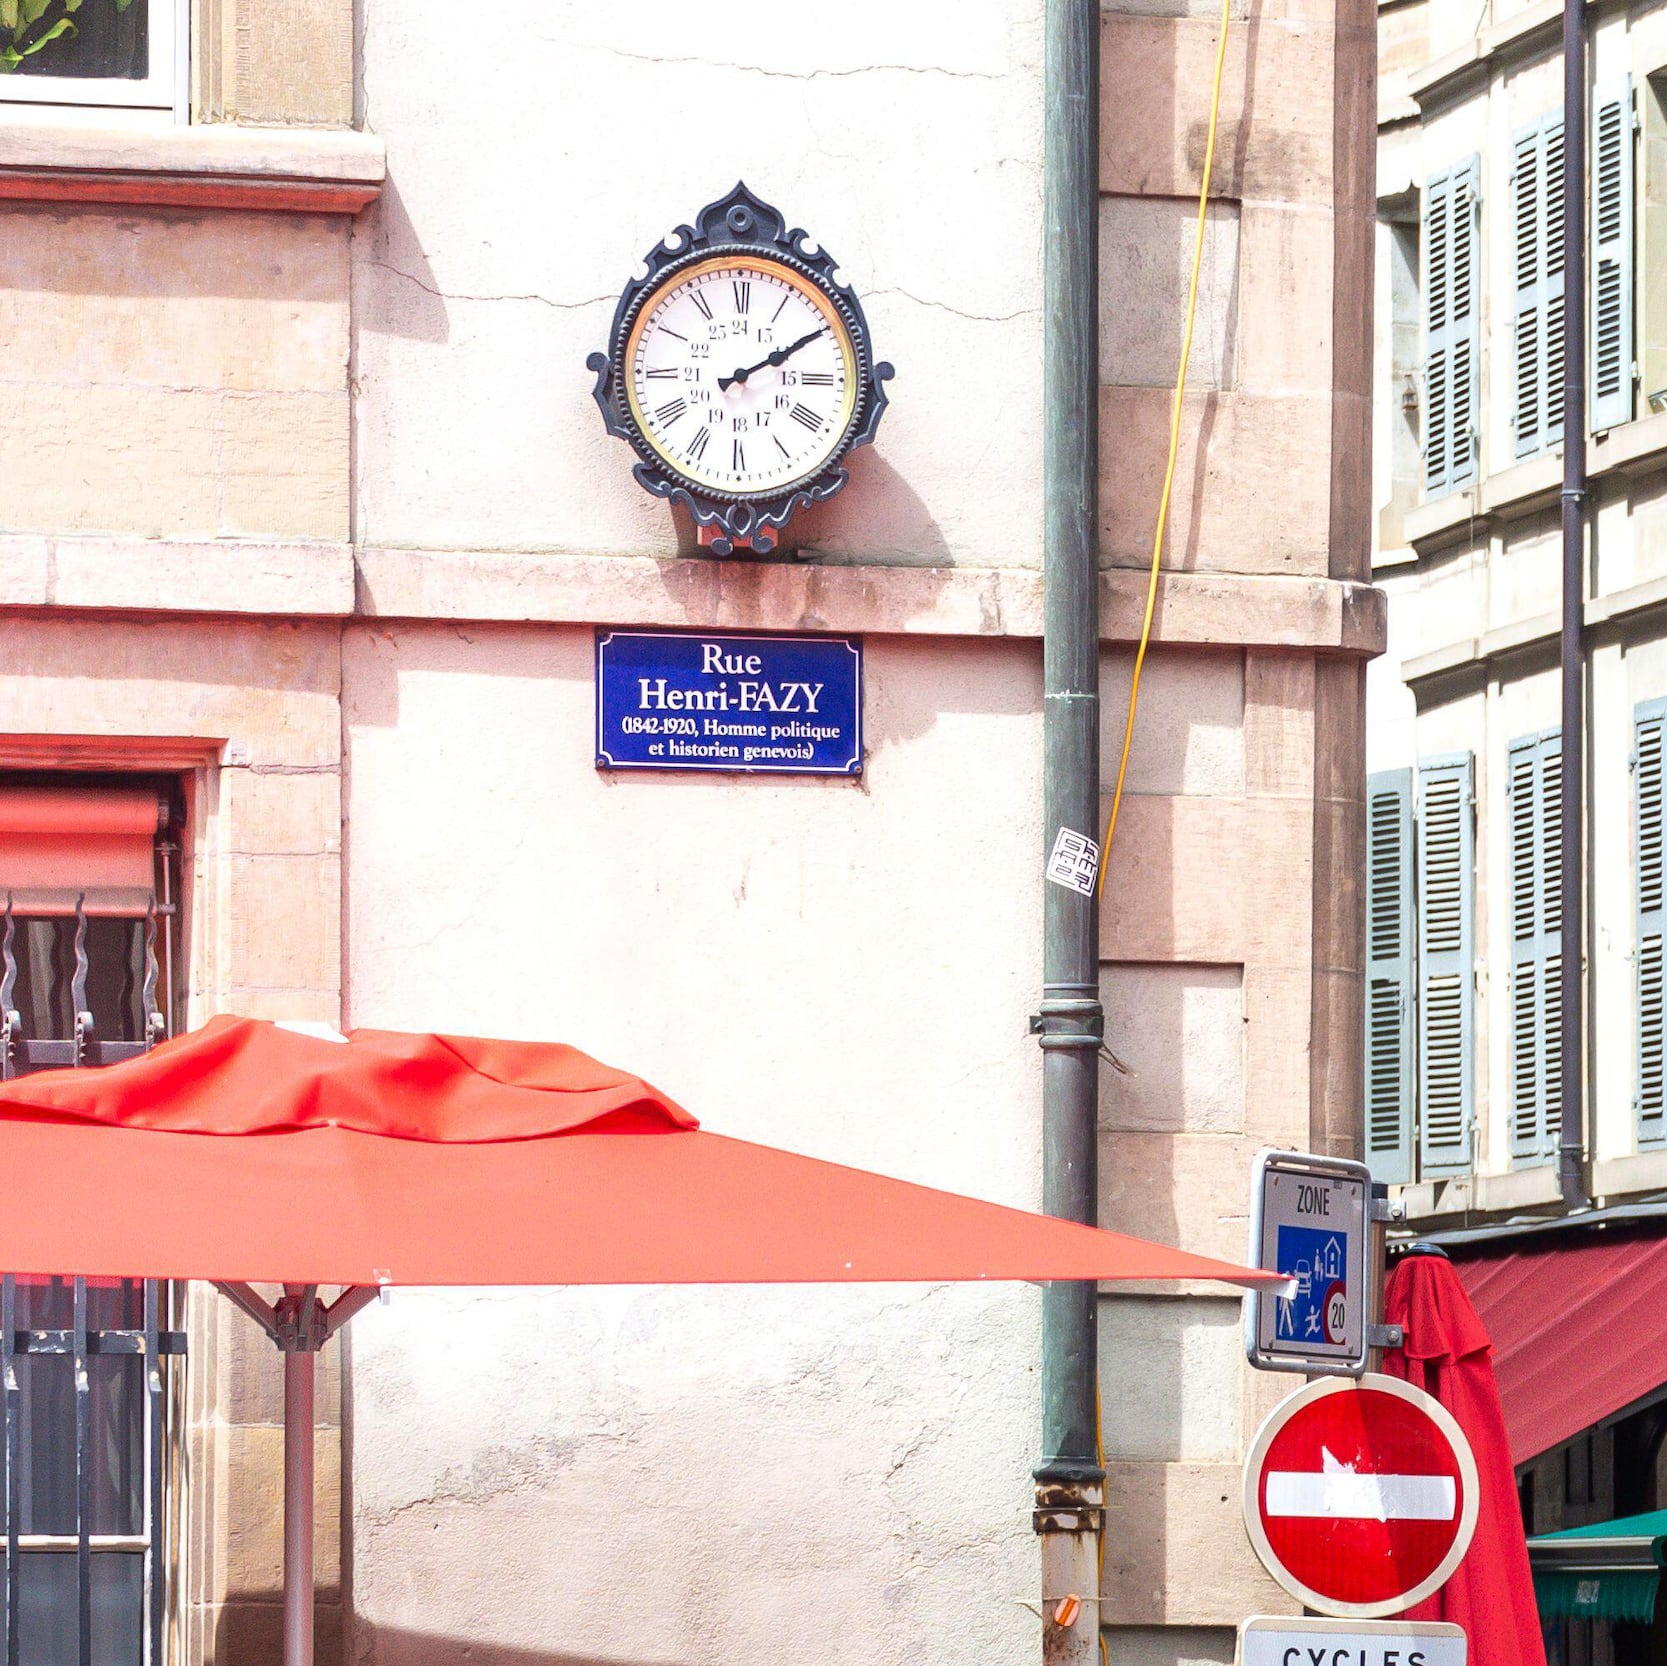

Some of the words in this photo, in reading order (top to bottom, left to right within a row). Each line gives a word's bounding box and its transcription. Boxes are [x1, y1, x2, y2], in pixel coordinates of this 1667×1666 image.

[708, 325, 727, 341] 23
[732, 319, 748, 335] 24
[757, 328, 773, 344] 13
[691, 343, 710, 359] 22
[684, 367, 701, 383] 21
[781, 370, 797, 387] 15
[690, 389, 710, 405] 20
[775, 393, 790, 409] 16
[707, 408, 724, 425] 19
[755, 411, 772, 428] 17
[732, 417, 748, 434] 18
[701, 643, 763, 676] Rue
[638, 678, 825, 714] Henri-FAZY
[621, 715, 700, 739] (1842-1920,
[703, 719, 767, 738] Homme
[771, 720, 842, 742] politique
[648, 741, 665, 757] et
[669, 739, 740, 758] historien
[743, 742, 816, 761] genevois)
[1297, 1184, 1331, 1217] ZONE
[1332, 1302, 1345, 1329] 20
